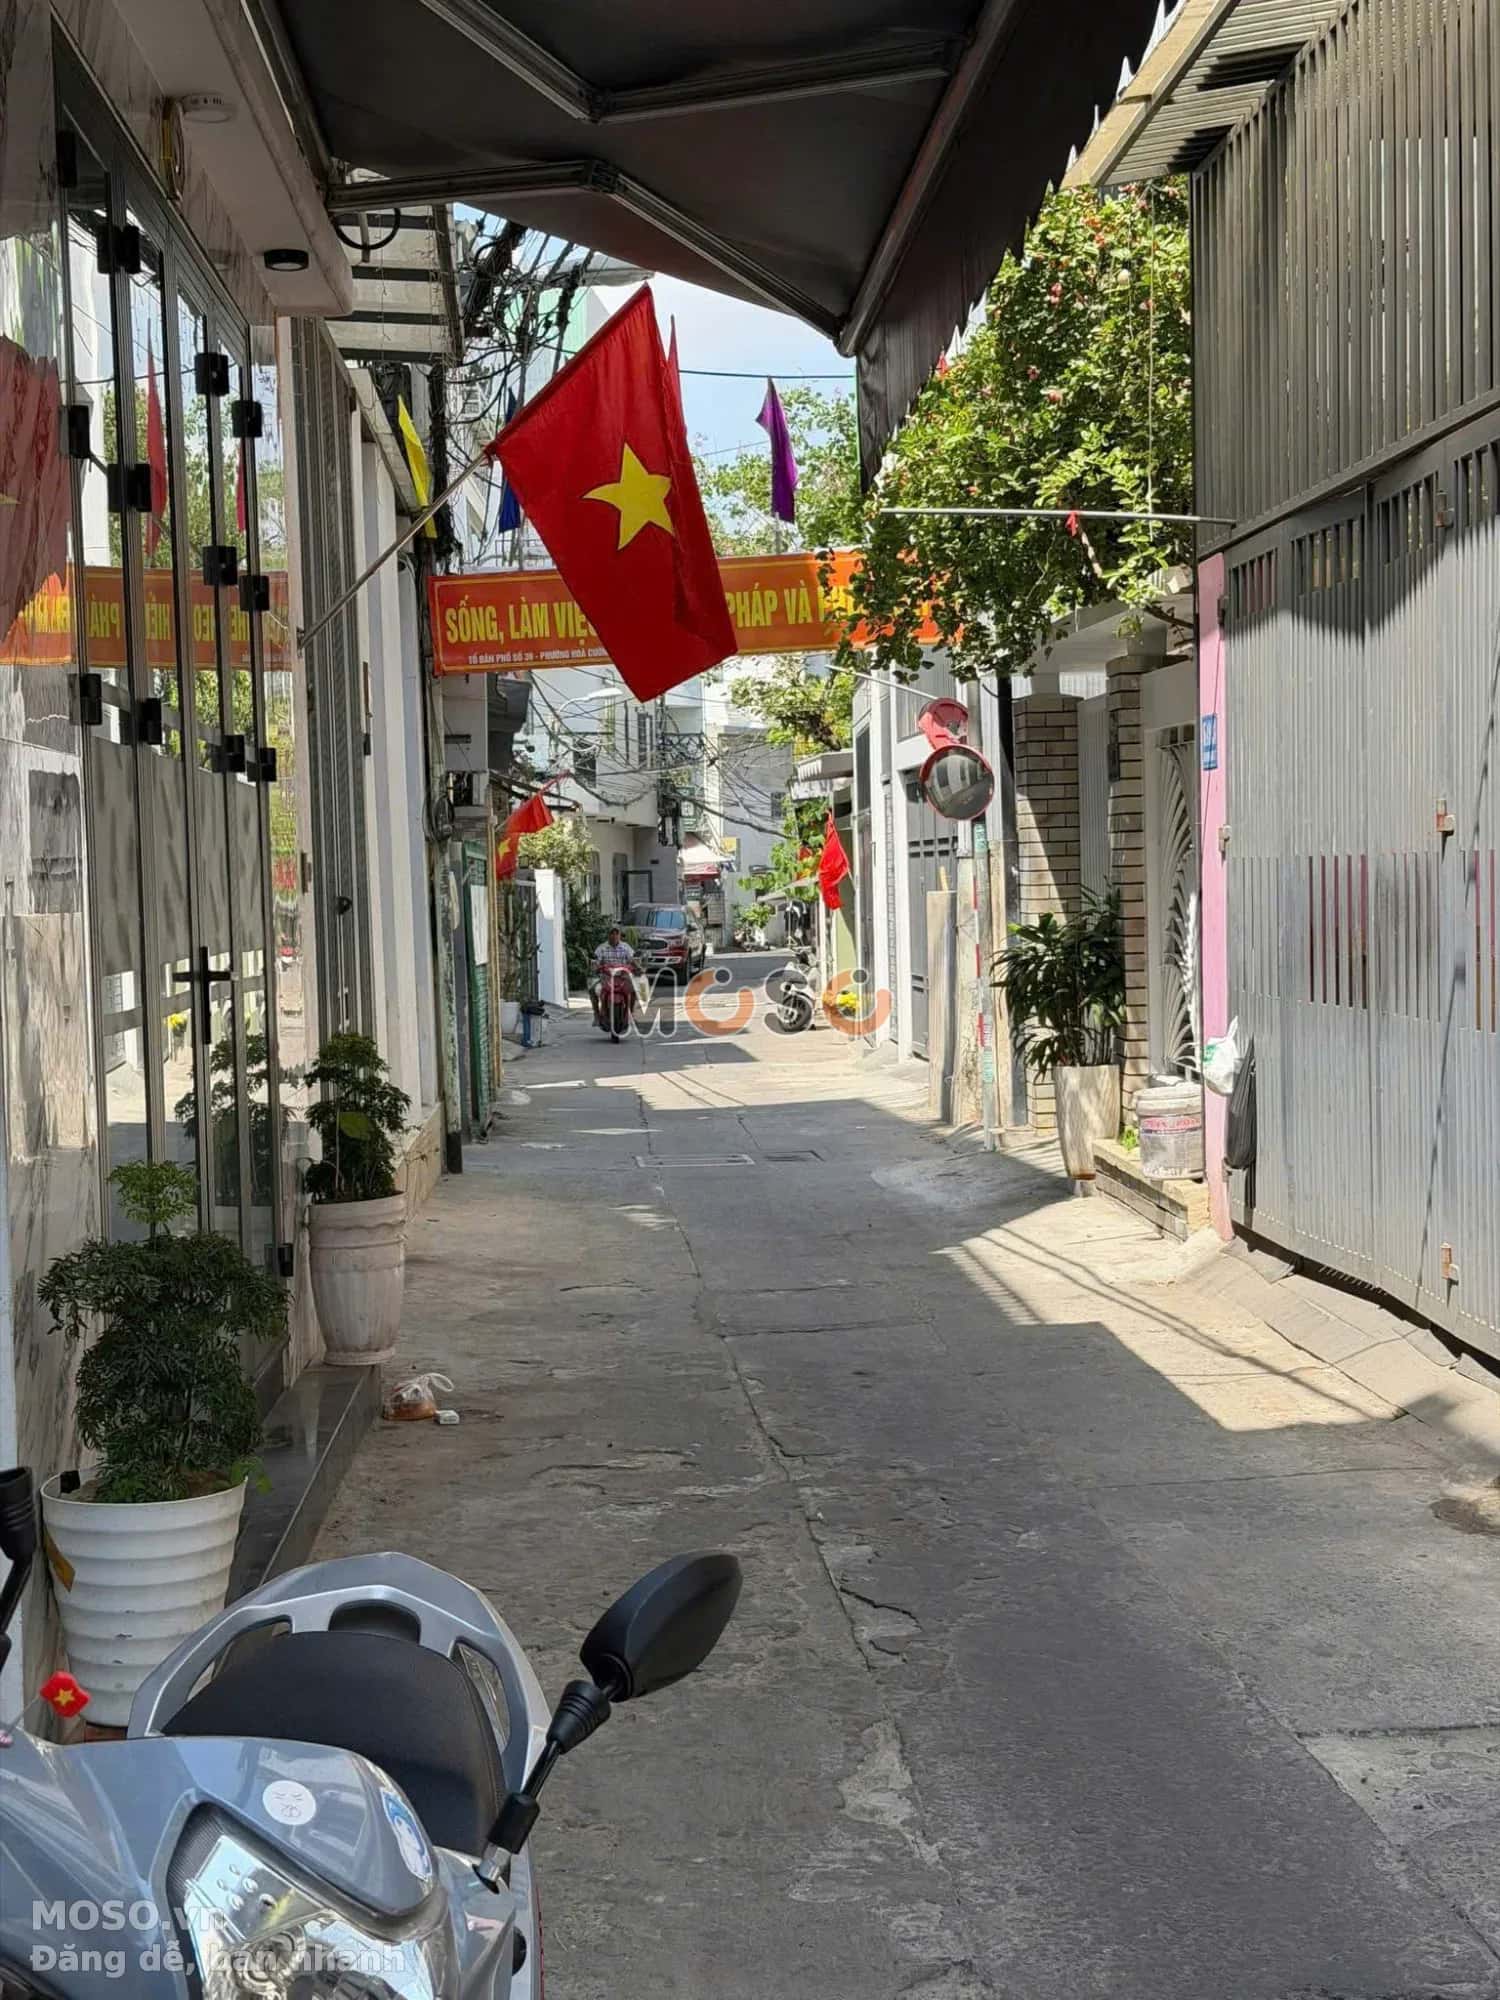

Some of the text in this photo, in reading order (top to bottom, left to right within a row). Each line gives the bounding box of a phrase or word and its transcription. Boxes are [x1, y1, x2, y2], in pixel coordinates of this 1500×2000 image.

[445, 594, 504, 644] SỐNG,
[508, 596, 550, 640] LÀM
[783, 580, 813, 625] VÀ
